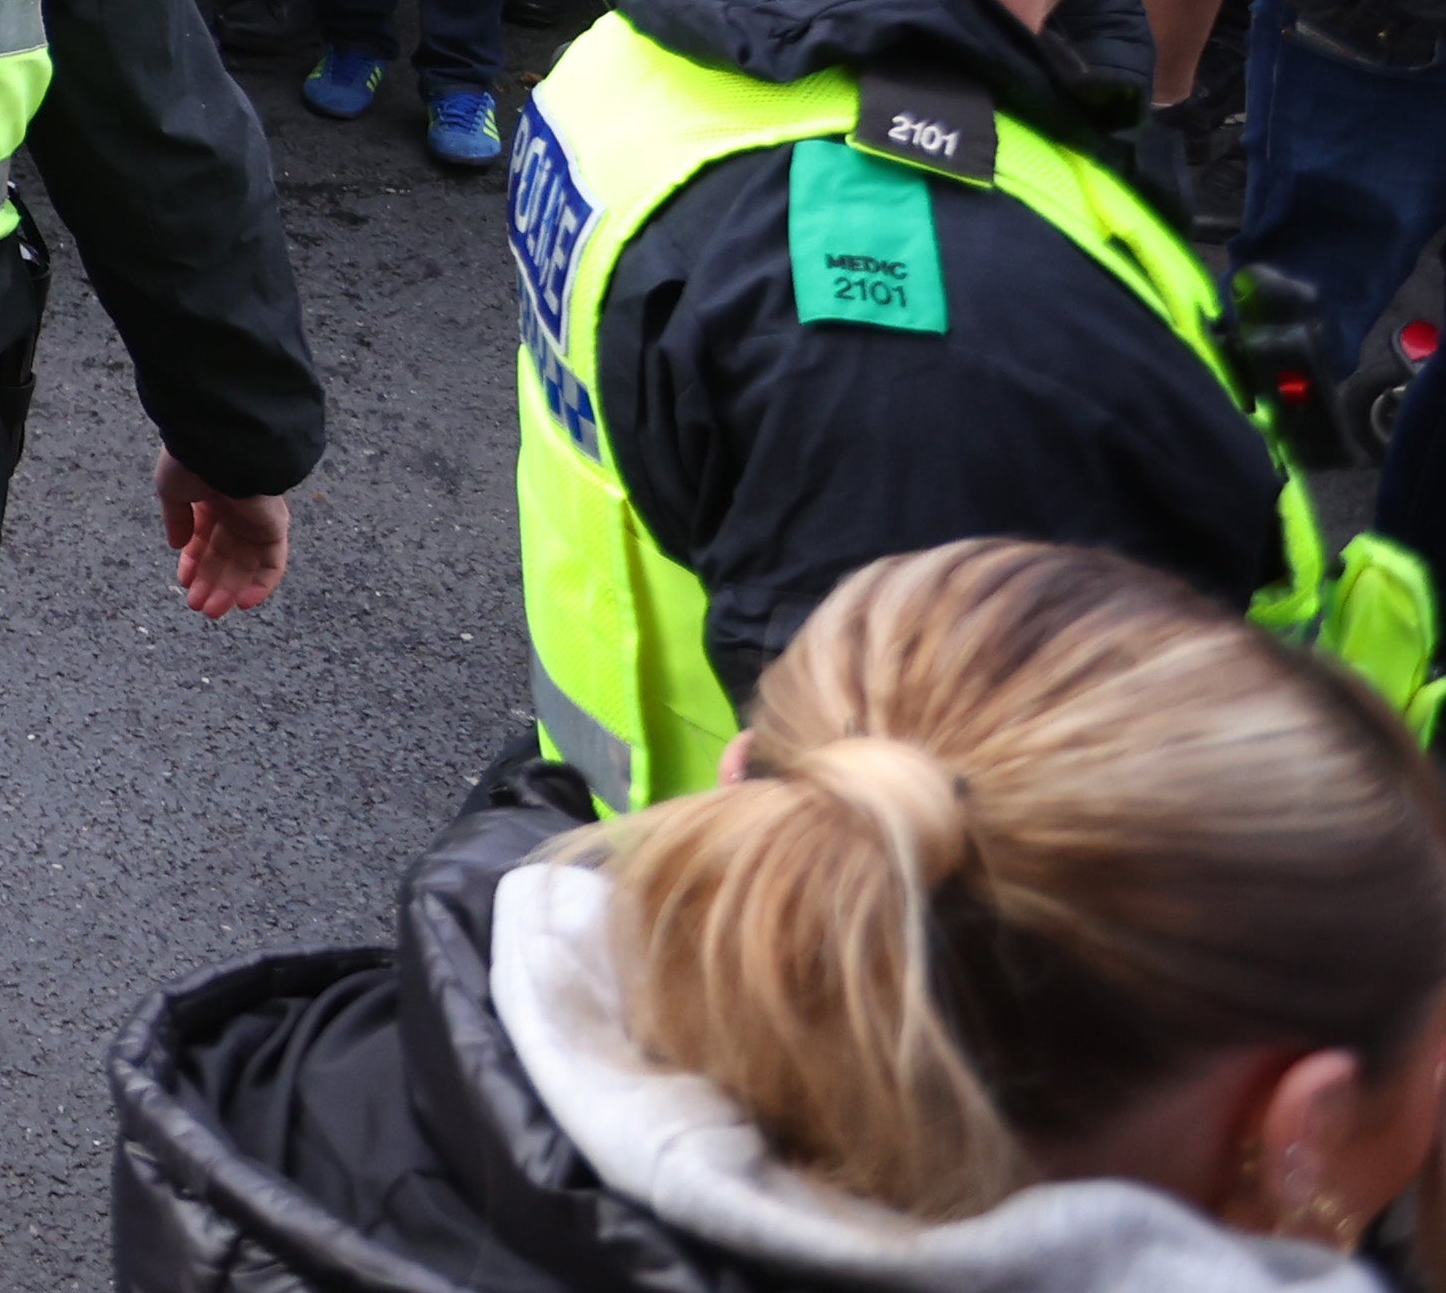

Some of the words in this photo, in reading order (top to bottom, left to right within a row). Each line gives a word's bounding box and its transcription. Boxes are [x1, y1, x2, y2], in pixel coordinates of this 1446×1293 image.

[887, 114, 960, 159] 2101
[824, 252, 908, 281] MEDIC
[834, 276, 908, 308] 2101
